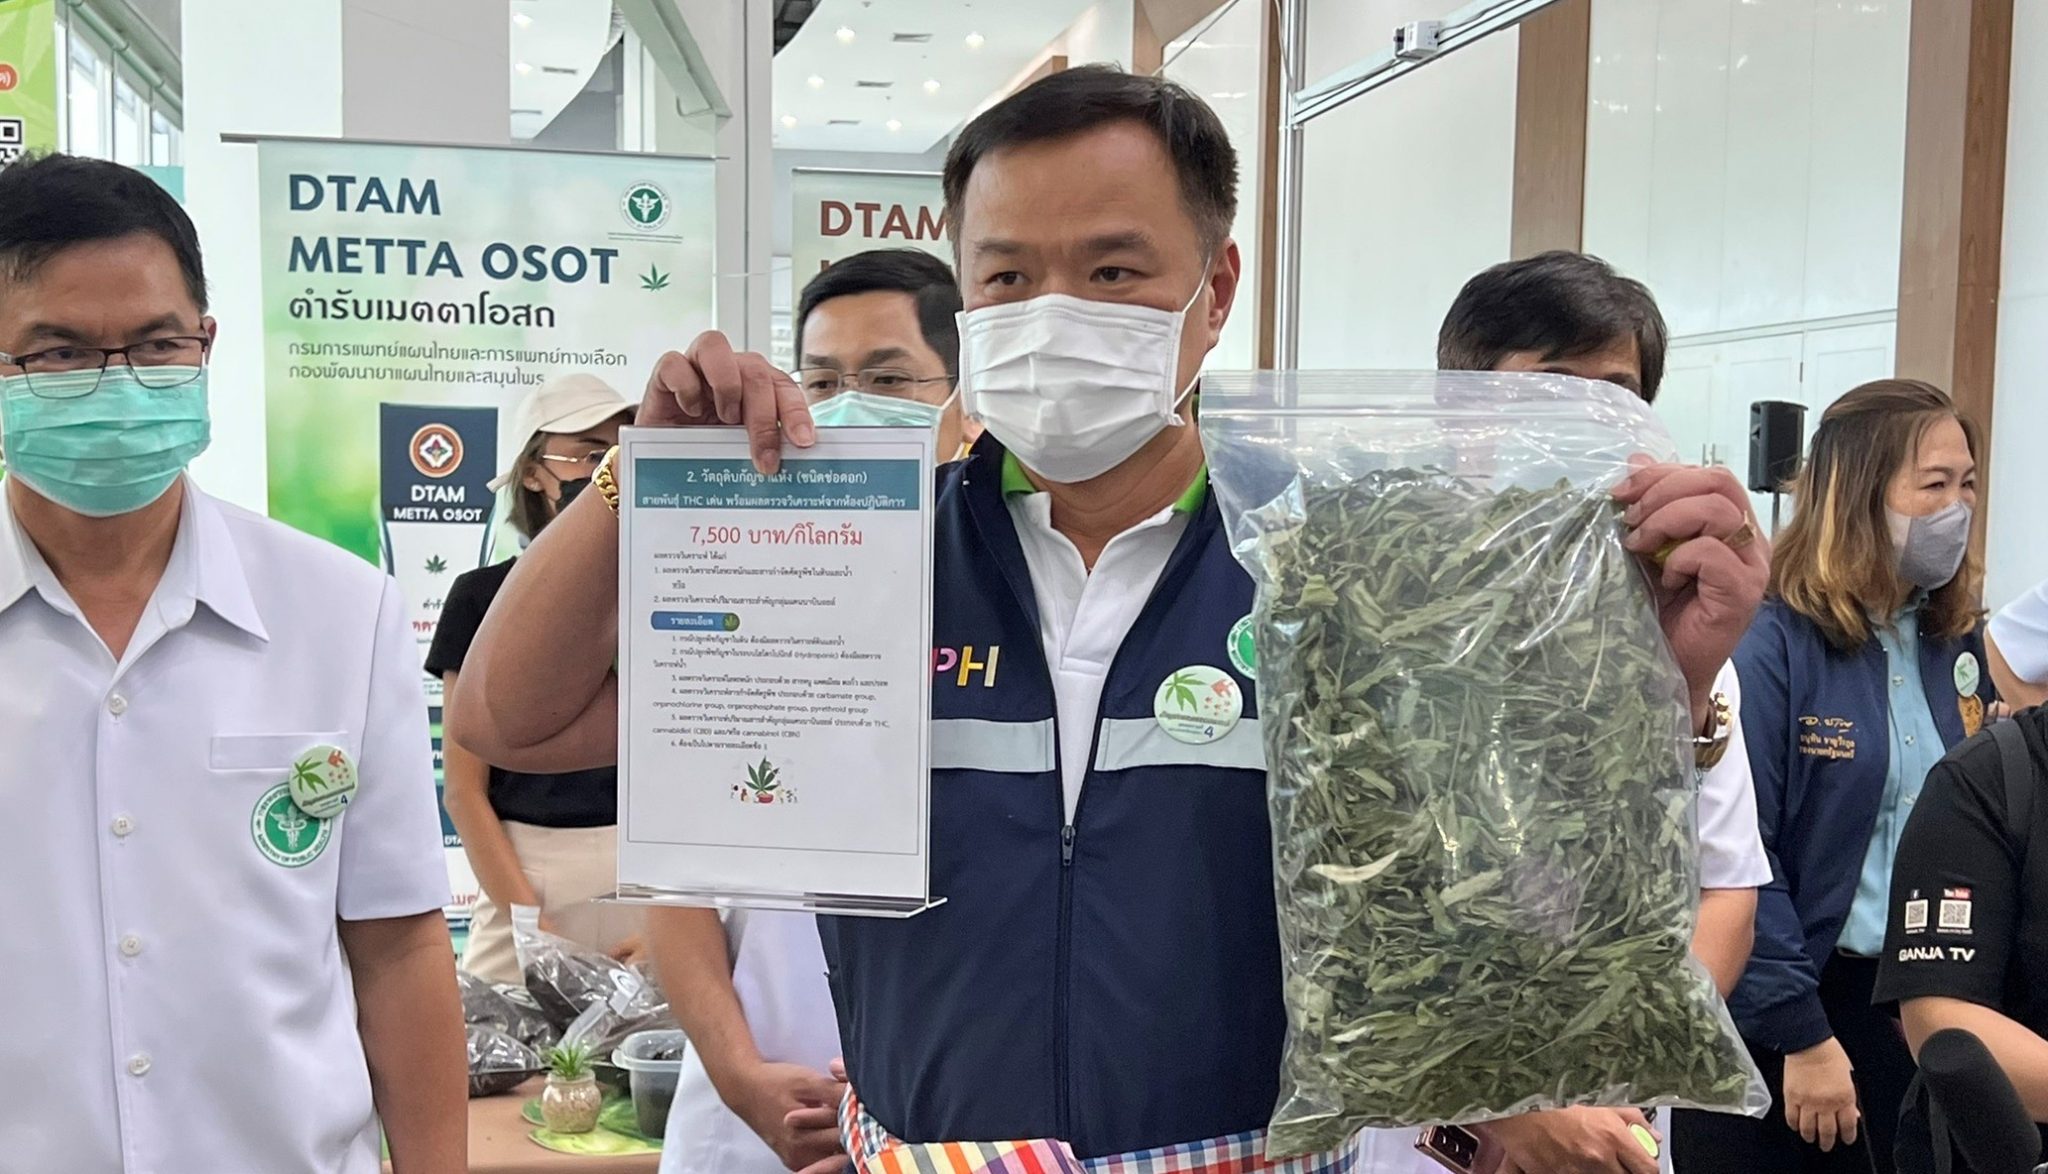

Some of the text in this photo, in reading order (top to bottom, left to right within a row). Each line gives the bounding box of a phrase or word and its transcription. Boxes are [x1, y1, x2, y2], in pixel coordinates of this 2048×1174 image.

[289, 174, 441, 216] DTAM
[288, 236, 619, 284] METTA OSOT
[289, 288, 555, 328] ตำรับเมตตาโอสถ
[289, 341, 627, 366] กรมการแพทย์แผนไทยและการแพทย์ทางเลือก
[289, 362, 545, 388] กองพัฒนายาแผนไทยและสมุนไพร
[796, 469, 867, 484] (ชนิดช่อดอก)
[411, 485, 465, 503] DTAM
[682, 495, 703, 506] THC
[706, 494, 722, 506] เด่น
[393, 507, 482, 521] METTA OSOT
[690, 522, 863, 547] 7,500 บาท/กิโลกรัม
[1204, 726, 1215, 738] 4
[1898, 946, 1976, 962] GANJA TV
